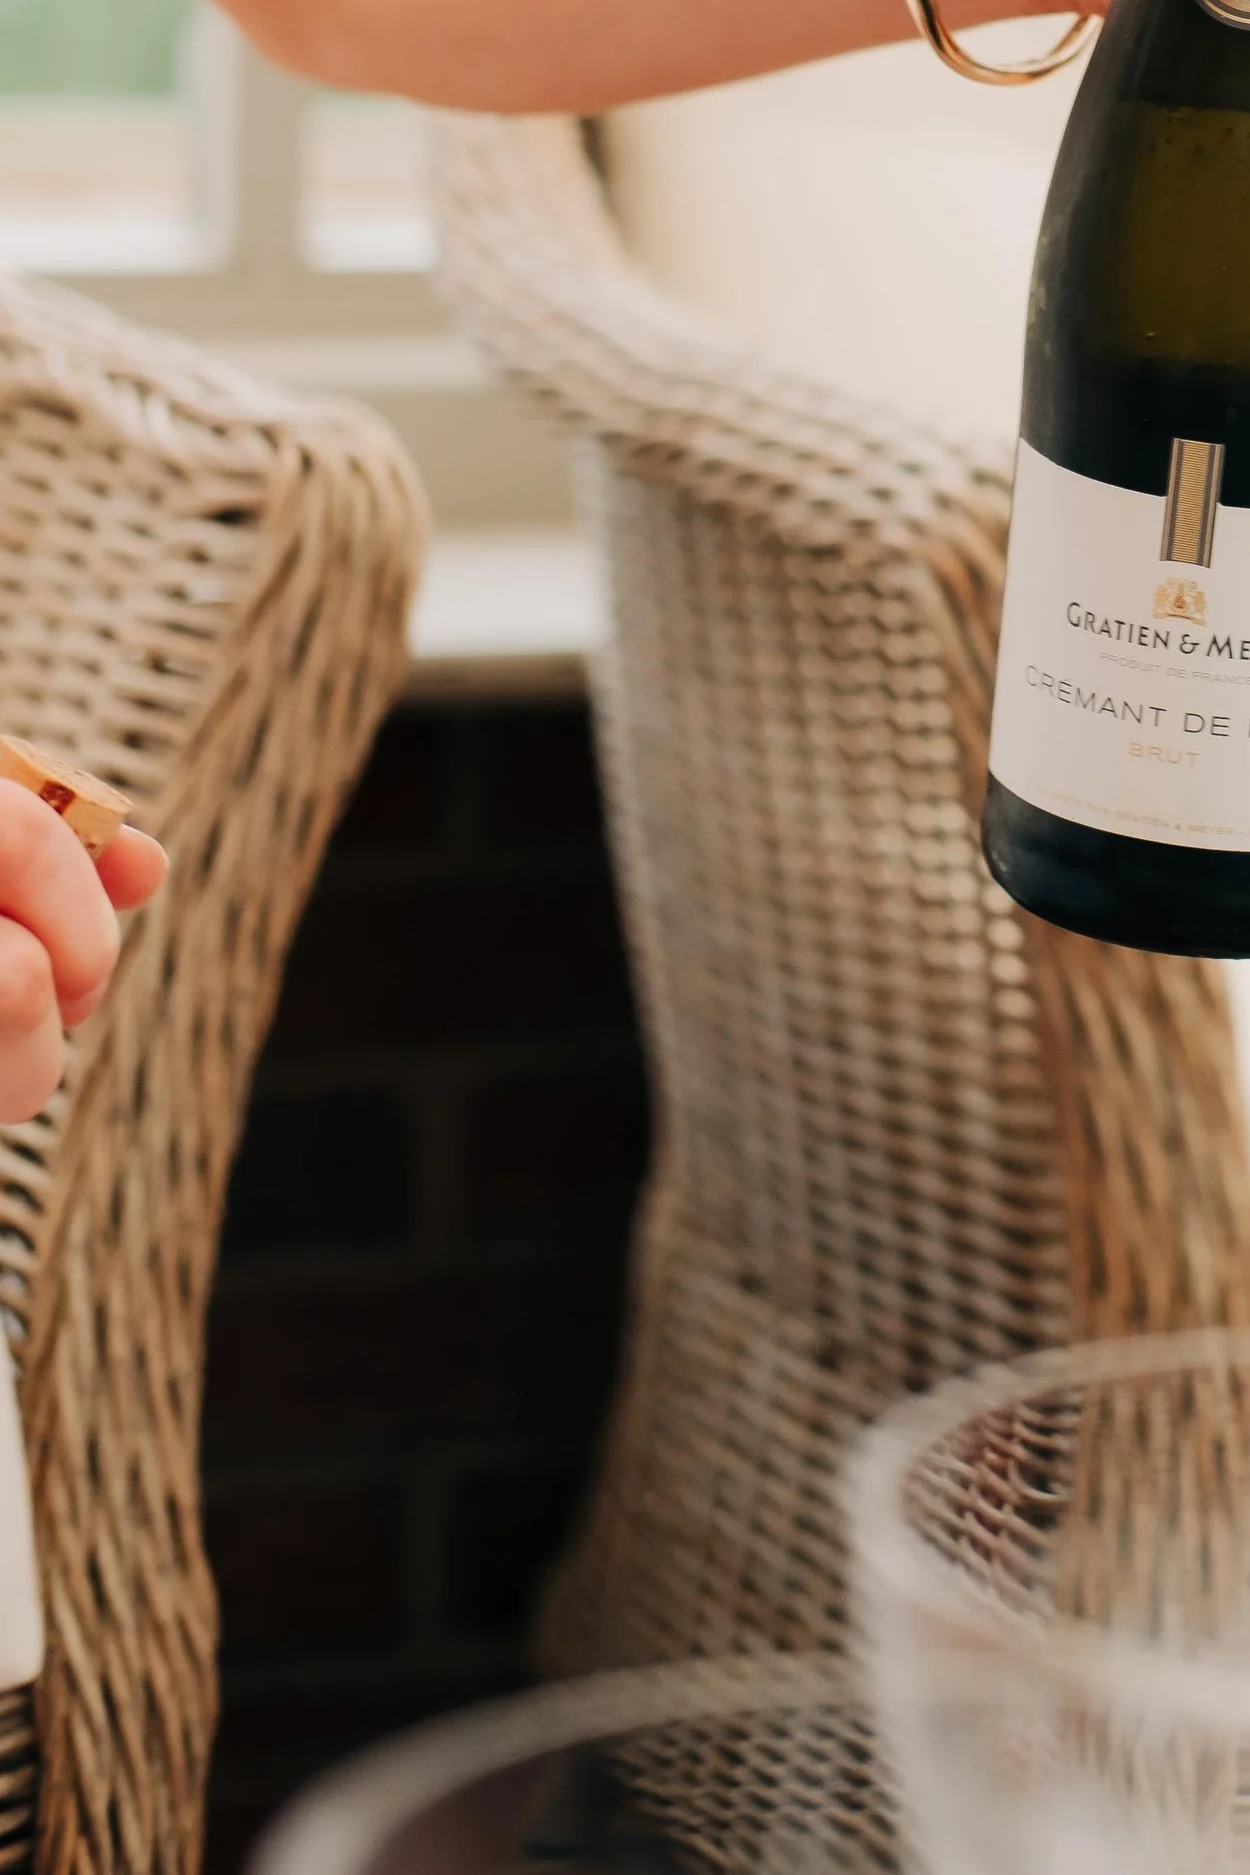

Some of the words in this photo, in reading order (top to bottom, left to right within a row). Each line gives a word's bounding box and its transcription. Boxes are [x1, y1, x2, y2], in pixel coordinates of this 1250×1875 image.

[1066, 601, 1171, 650] GRATIEN
[1179, 633, 1200, 654] &
[1099, 652, 1162, 673] PRODUIT
[1166, 667, 1186, 679] DE
[1025, 665, 1168, 728] CRÉMANT
[1183, 712, 1231, 737] DE
[1128, 742, 1199, 766] BRUT
